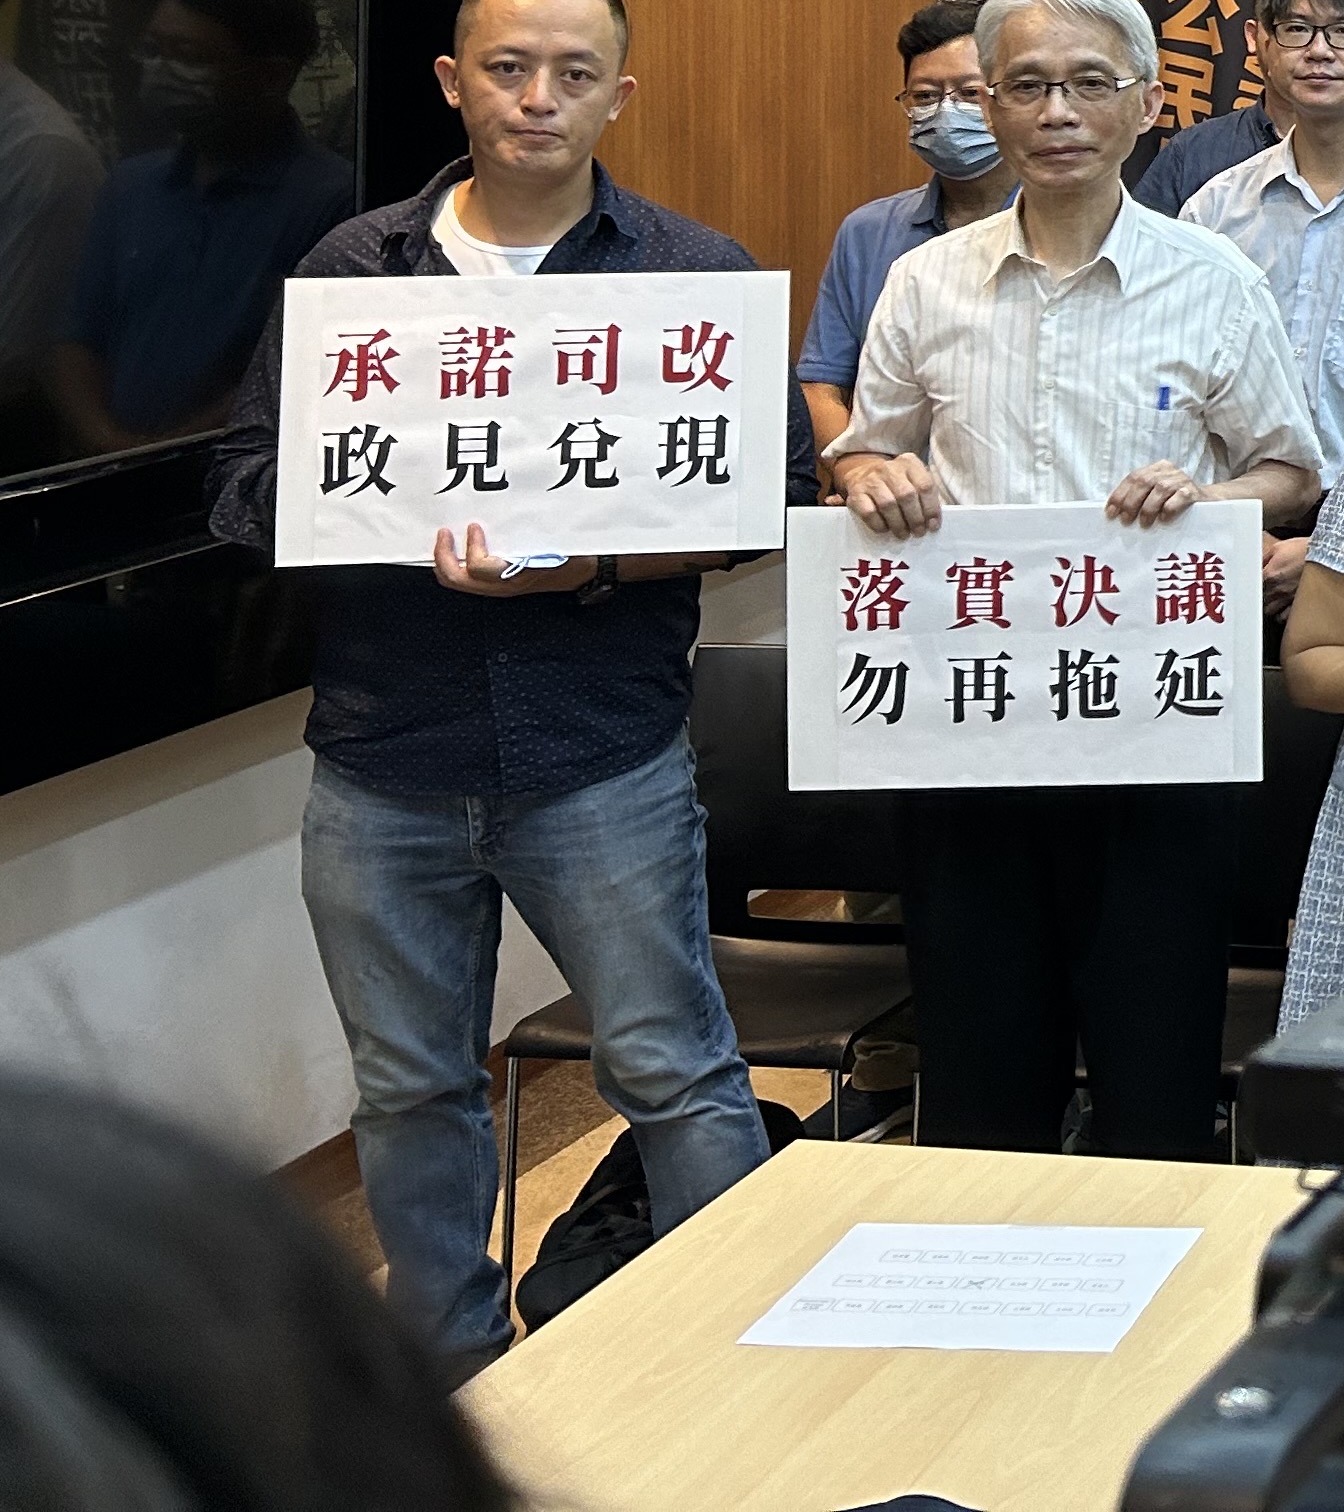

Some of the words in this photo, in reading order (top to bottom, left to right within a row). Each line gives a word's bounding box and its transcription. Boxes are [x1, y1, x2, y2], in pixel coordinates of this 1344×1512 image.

[323, 321, 735, 402] 承諾司改
[319, 414, 731, 498] 政見兌現
[840, 550, 1226, 632] 落實決議
[840, 645, 1223, 726] 勿再拖延
